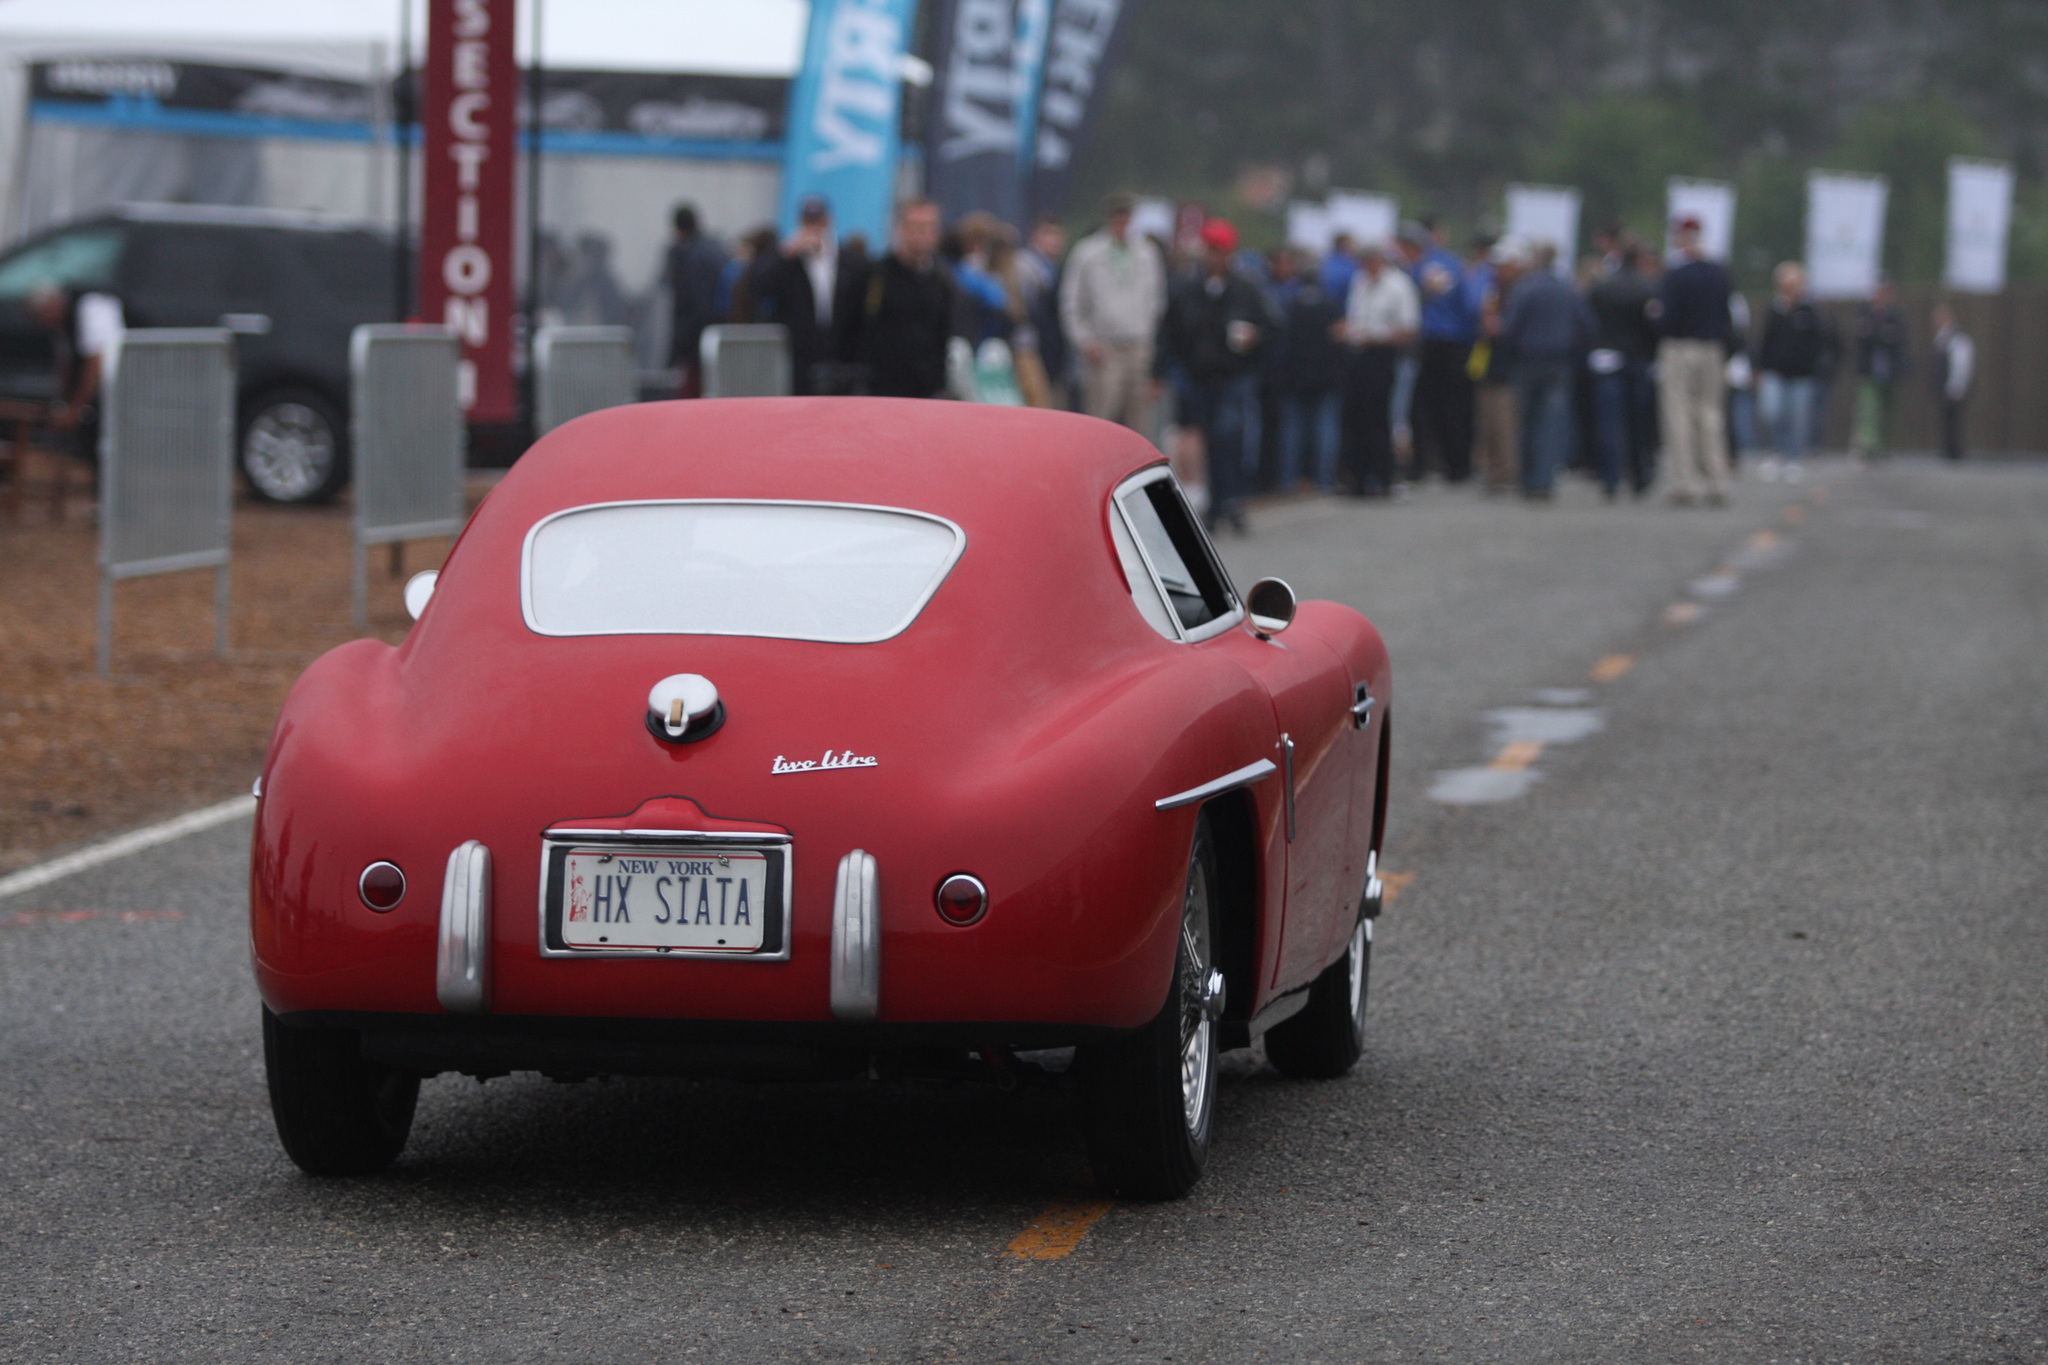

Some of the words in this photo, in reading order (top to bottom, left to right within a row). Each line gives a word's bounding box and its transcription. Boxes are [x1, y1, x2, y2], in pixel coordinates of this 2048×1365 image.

[442, 0, 491, 346] SECTION
[772, 755, 817, 772] two
[821, 749, 877, 767] litre
[618, 859, 659, 874] NEW
[668, 860, 714, 876] YORK
[593, 874, 632, 923] HX
[655, 876, 751, 926] SIATA
